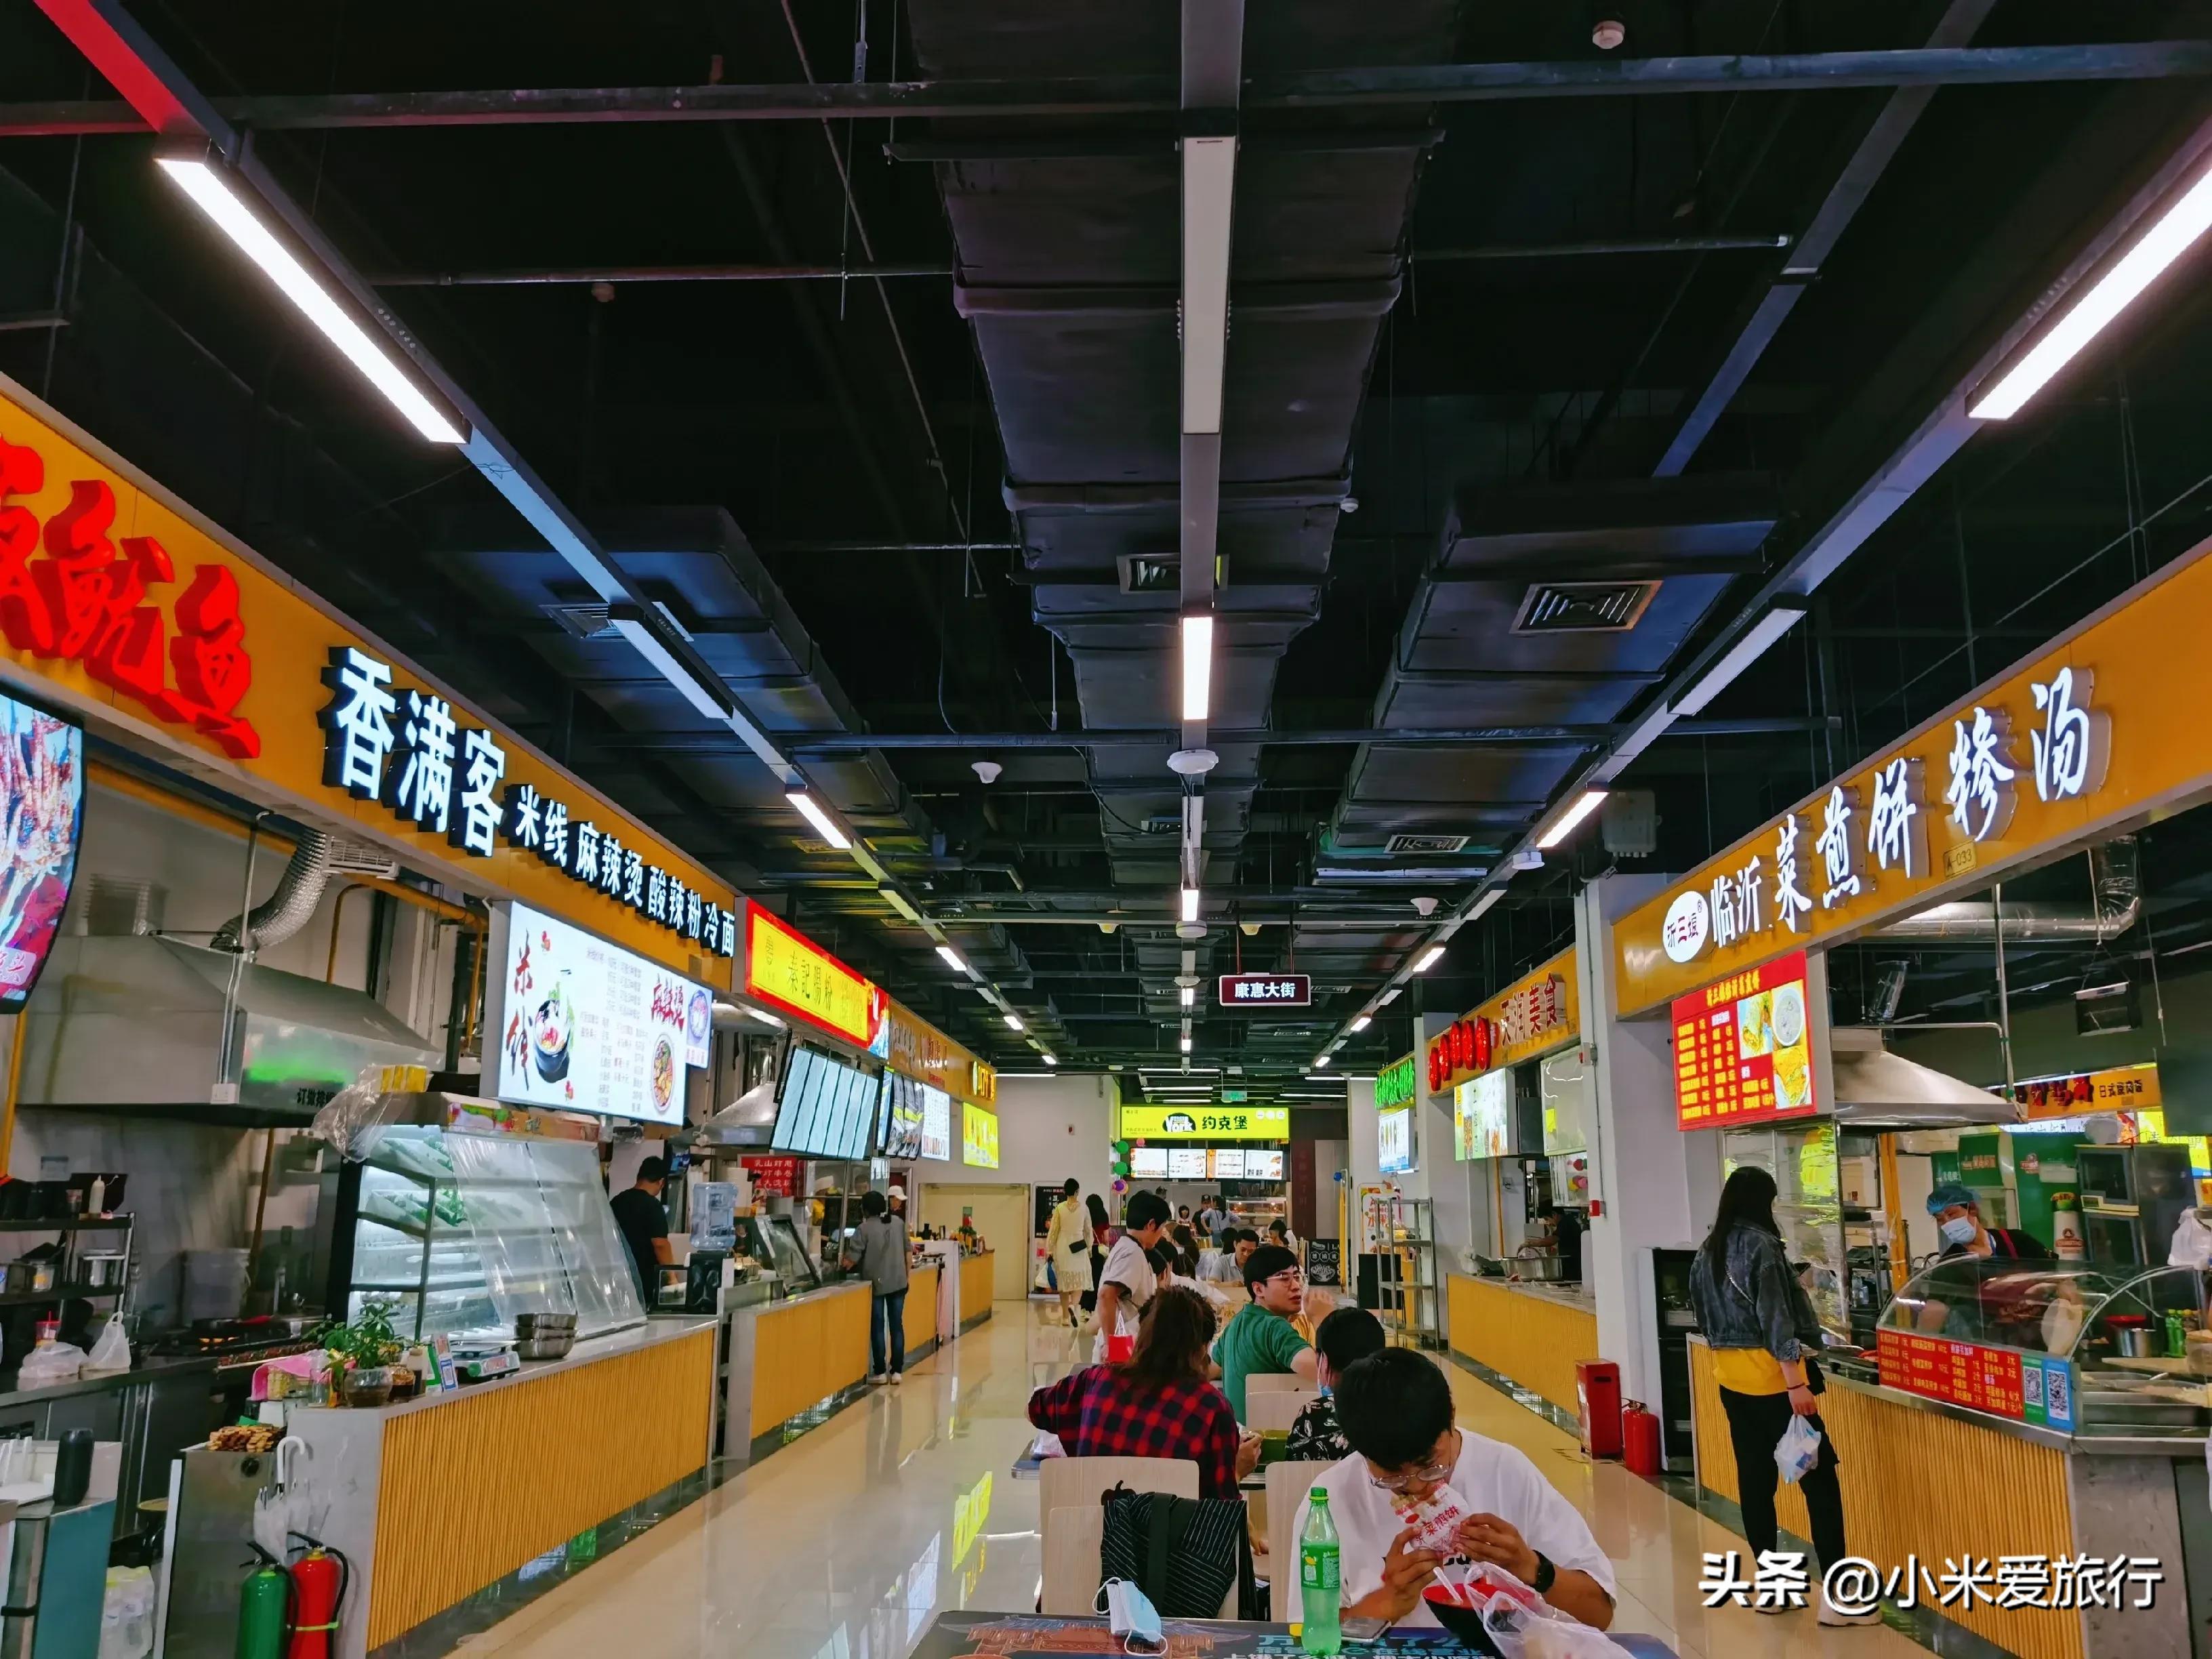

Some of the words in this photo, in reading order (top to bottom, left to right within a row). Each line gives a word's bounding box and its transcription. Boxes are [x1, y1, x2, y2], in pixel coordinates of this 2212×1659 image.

[333, 647, 506, 857] 香满客
[516, 784, 569, 867] 米线
[575, 821, 644, 908] 麻辣烫
[1947, 848, 1972, 872] A-033
[1235, 982, 1296, 998] 康惠大街
[1202, 1115, 1248, 1130] 约克堡
